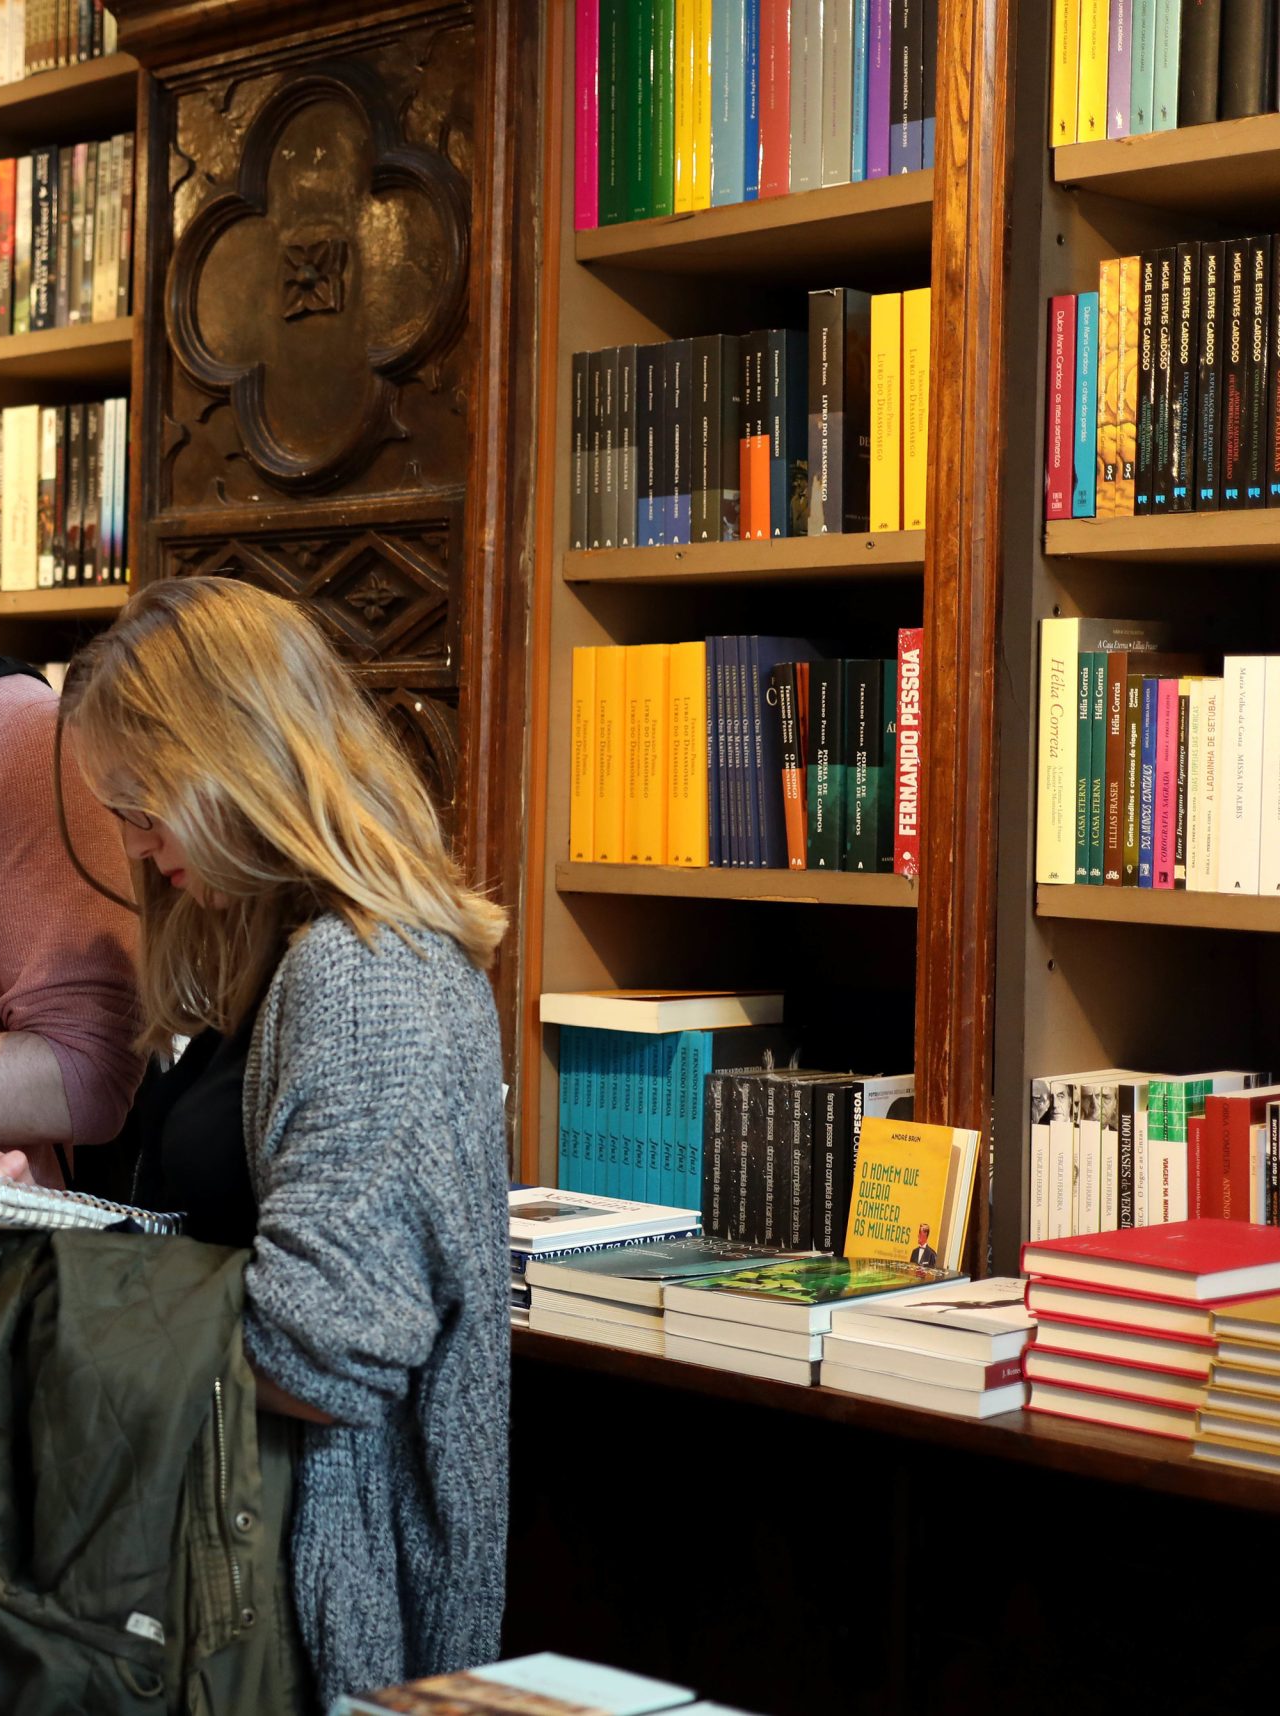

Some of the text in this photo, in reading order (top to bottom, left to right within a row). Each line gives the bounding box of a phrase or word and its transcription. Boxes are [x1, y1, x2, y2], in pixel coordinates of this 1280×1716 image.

[1180, 256, 1191, 364] MIGUEL ESTEVES CARDOSO
[1206, 256, 1216, 364] MIGUEL ESTEVES CARDOSO
[1231, 253, 1241, 363] MIGUEL ESTEVES CARDOSO
[1253, 250, 1263, 361] MIGUEL ESTEVES CARDOSO
[1055, 311, 1064, 389] Dulce Maria Cardoso
[876, 354, 885, 461] LIVRO DO DESASSOSSEGO
[1055, 393, 1061, 403] os
[822, 422, 828, 436] DO
[1207, 426, 1214, 434] DE
[1054, 426, 1062, 468] sentimentos
[1079, 667, 1089, 719] Hélia Correia
[1094, 667, 1104, 720] Hélia Correia
[1048, 658, 1065, 758] Hélia Correia
[898, 649, 920, 836] FERNANDO PESSOA
[1207, 736, 1215, 747] DE
[1237, 726, 1245, 747] Costa
[1130, 749, 1136, 758] de
[1178, 746, 1186, 785] Esperança
[1206, 751, 1215, 792] LADAINHA
[817, 784, 822, 796] DE
[822, 784, 828, 795] DE
[856, 787, 862, 798] DE
[861, 786, 866, 797] DE
[1078, 778, 1086, 812] ETERNA
[1092, 778, 1100, 812] ETERNA
[1236, 782, 1244, 793] IN
[1109, 782, 1118, 848] LILLIAS FRASER
[1160, 771, 1170, 863] COROGRAFIA SAGRADA
[1142, 836, 1151, 850] DOS
[793, 1090, 801, 1119] fernando
[826, 1092, 834, 1122] fernando
[853, 1092, 862, 1134] PESSOA
[892, 1133, 908, 1141] ANDRÉ
[1121, 1115, 1132, 1136] 1000
[826, 1152, 834, 1167] obra
[1121, 1138, 1131, 1178] FRASES
[824, 1168, 833, 1199] completa
[861, 1161, 920, 1187] O HOMEM QUE
[1121, 1179, 1130, 1190] de
[793, 1197, 800, 1205] de
[825, 1200, 832, 1209] de
[859, 1182, 890, 1202] QUERIA
[1162, 1188, 1169, 1197] NA
[1223, 1177, 1231, 1219] ANTÓNIO
[856, 1199, 900, 1223] CONHECER
[853, 1219, 911, 1245] AS MULHERES
